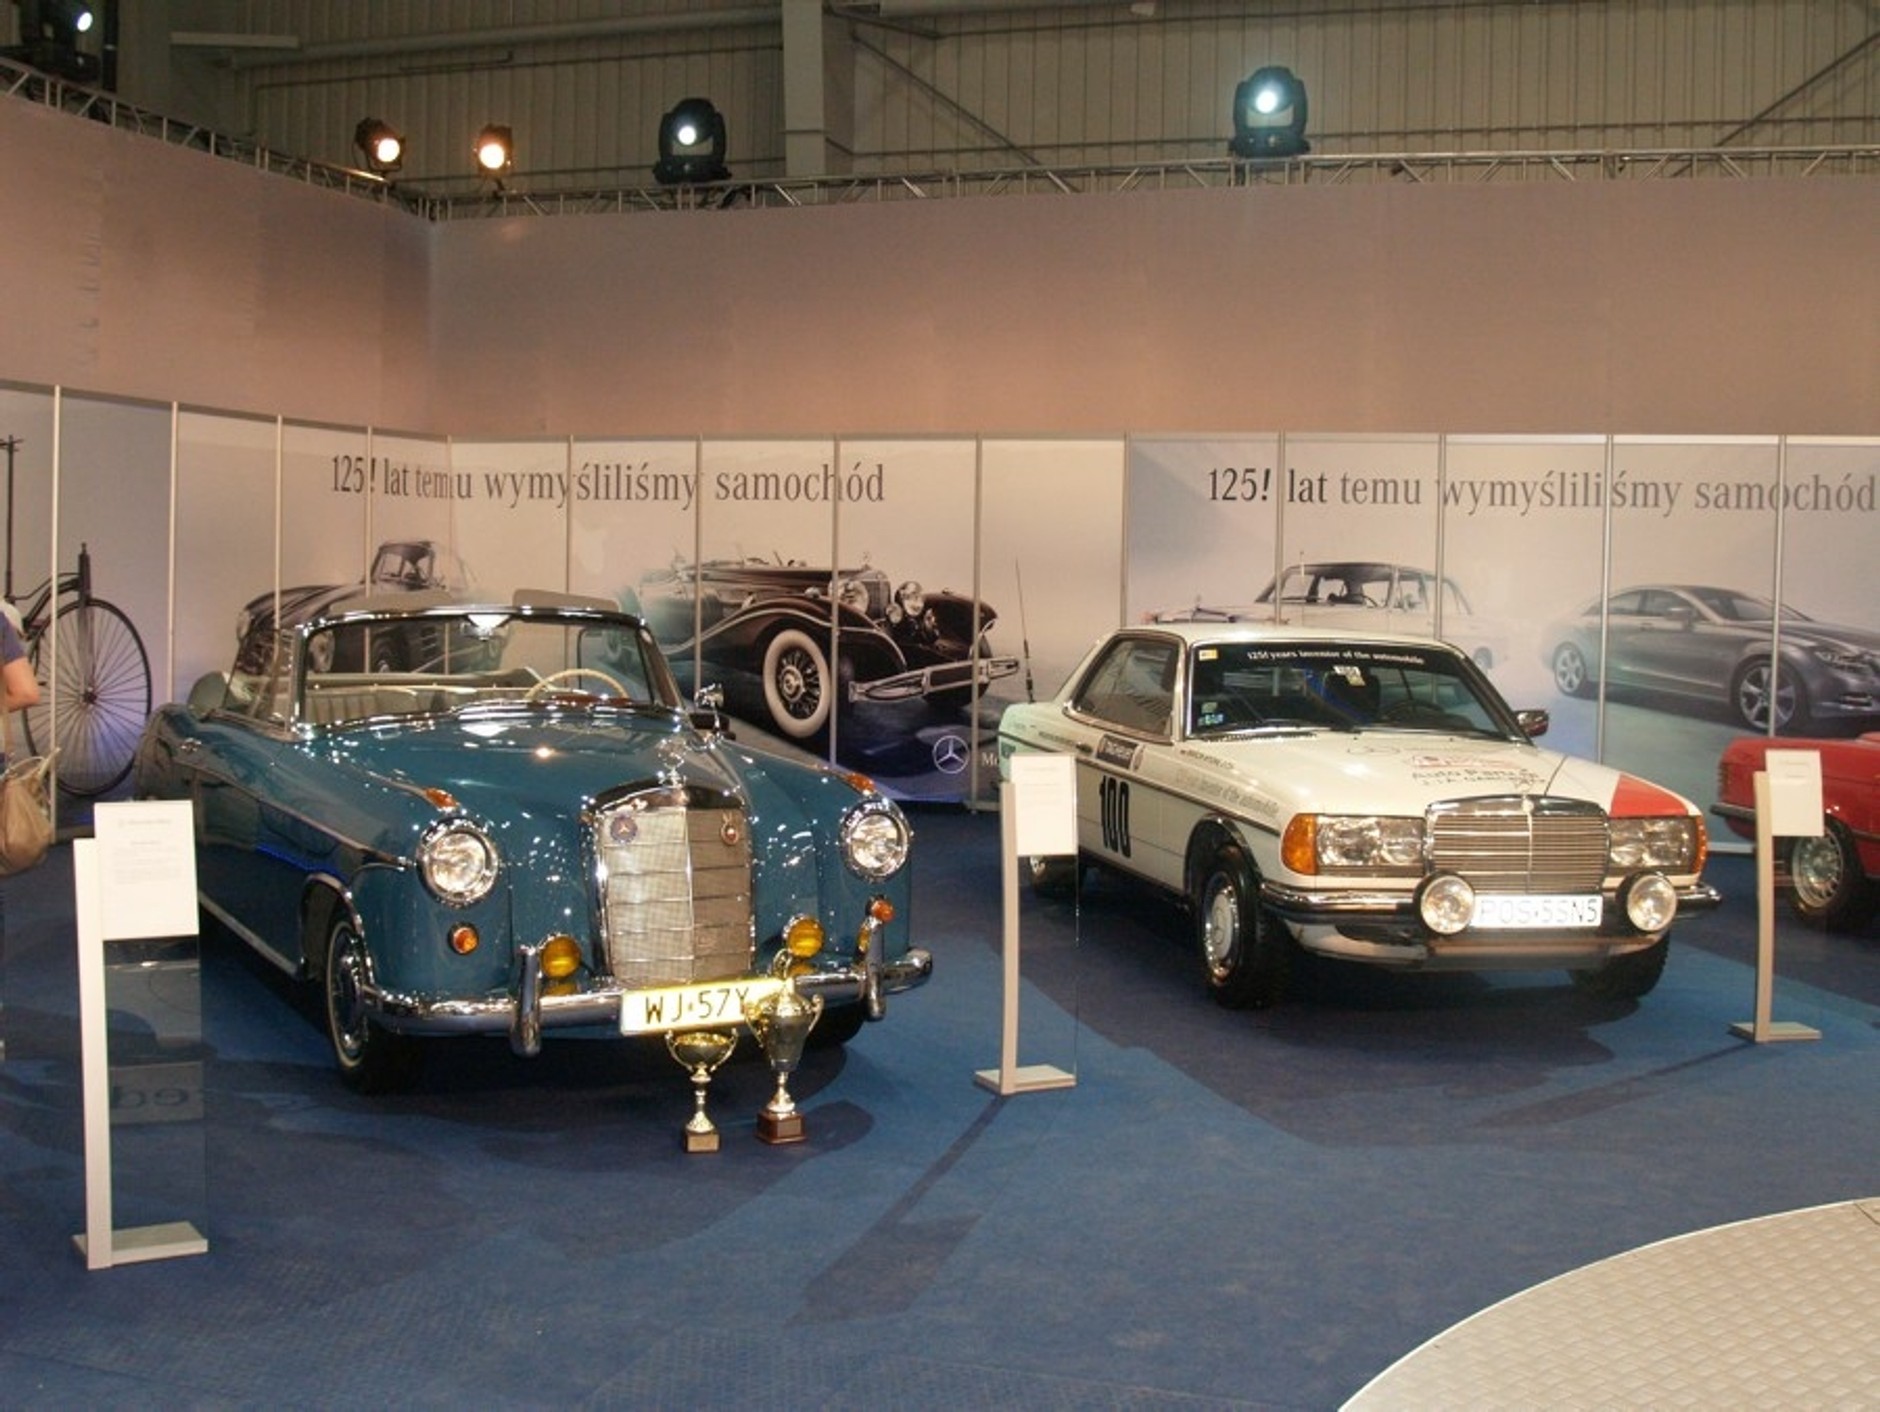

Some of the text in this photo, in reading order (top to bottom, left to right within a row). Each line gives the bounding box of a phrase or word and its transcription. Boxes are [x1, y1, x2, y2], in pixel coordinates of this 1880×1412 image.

[333, 454, 885, 511] 125! lat temu wymyśliliśmy samochód
[1208, 467, 1877, 518] 125! lat temu wymyśliliśmy samochód
[1098, 774, 1132, 859] 100
